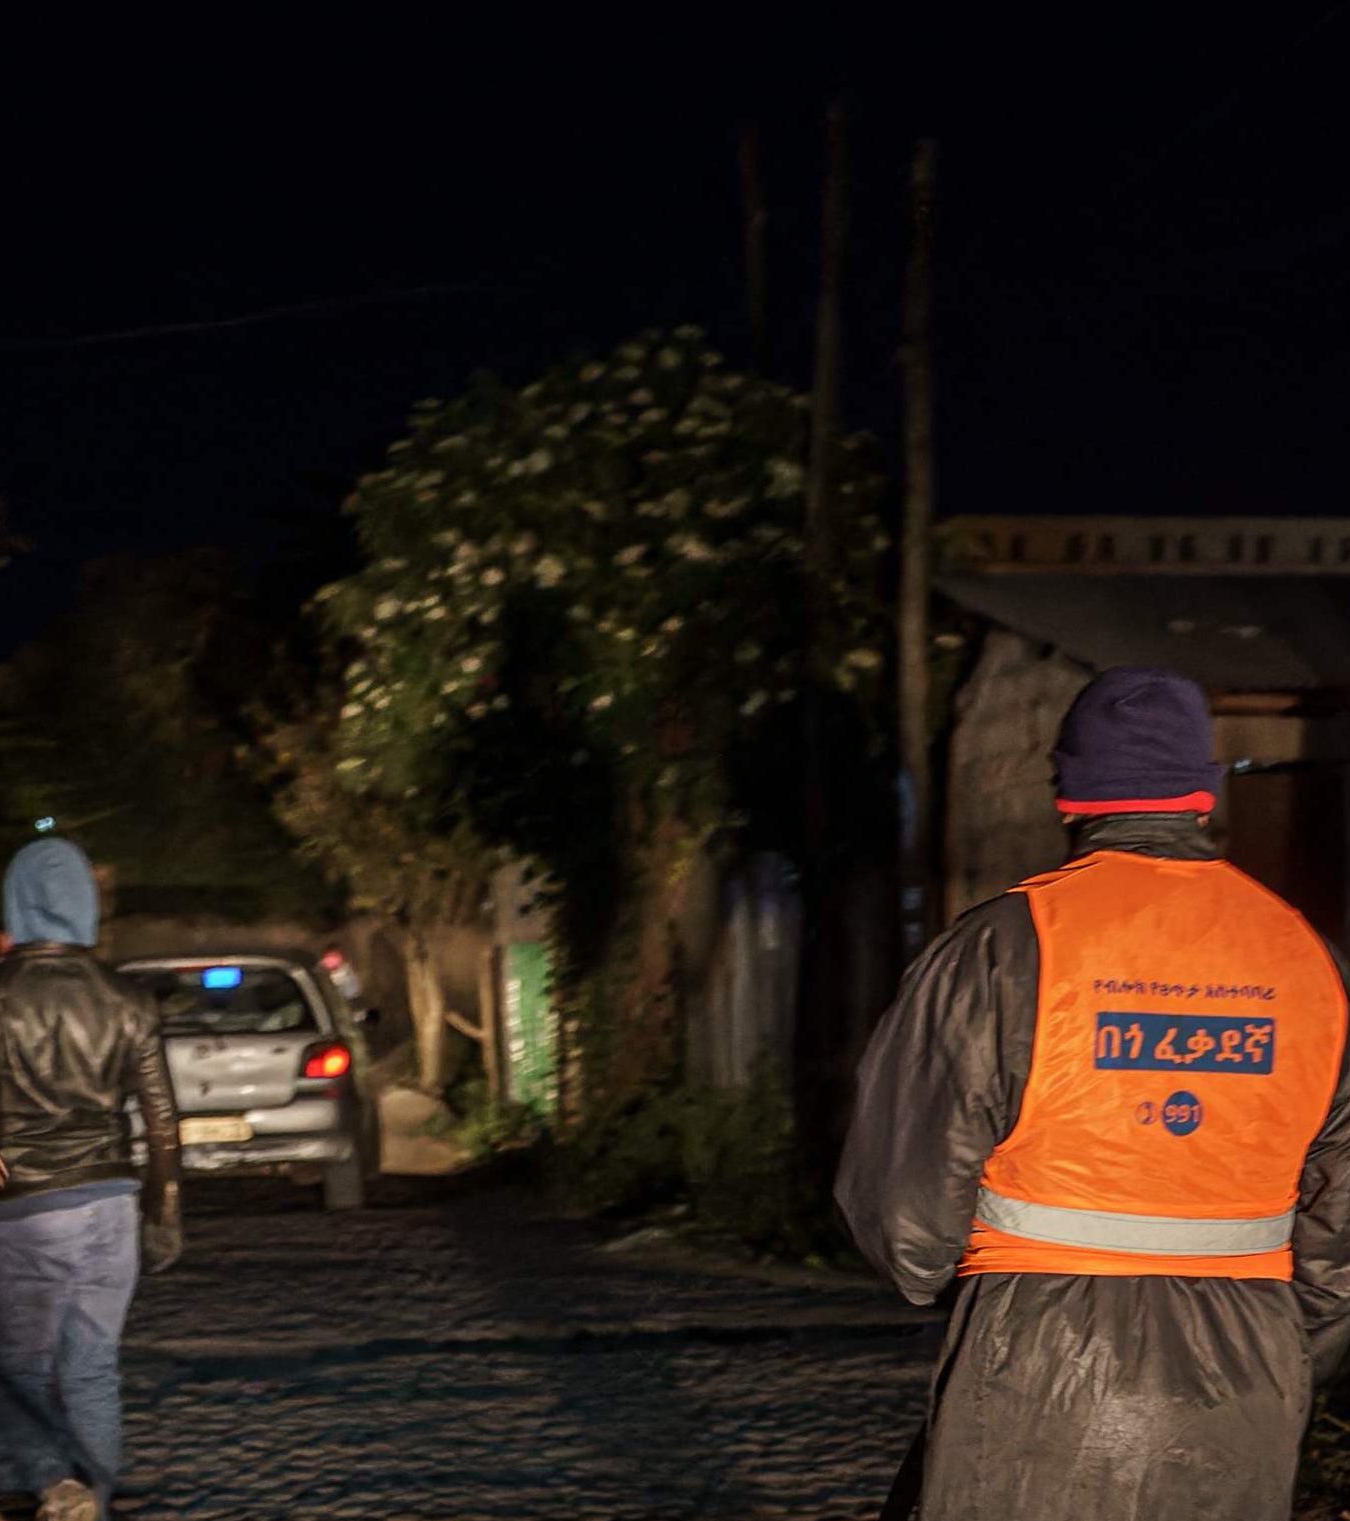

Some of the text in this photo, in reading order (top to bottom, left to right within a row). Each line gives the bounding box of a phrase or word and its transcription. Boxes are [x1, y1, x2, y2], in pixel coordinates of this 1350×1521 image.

[1097, 1023, 1273, 1064] በጎ ፈቃደኛ
[1164, 1103, 1200, 1124] 991
